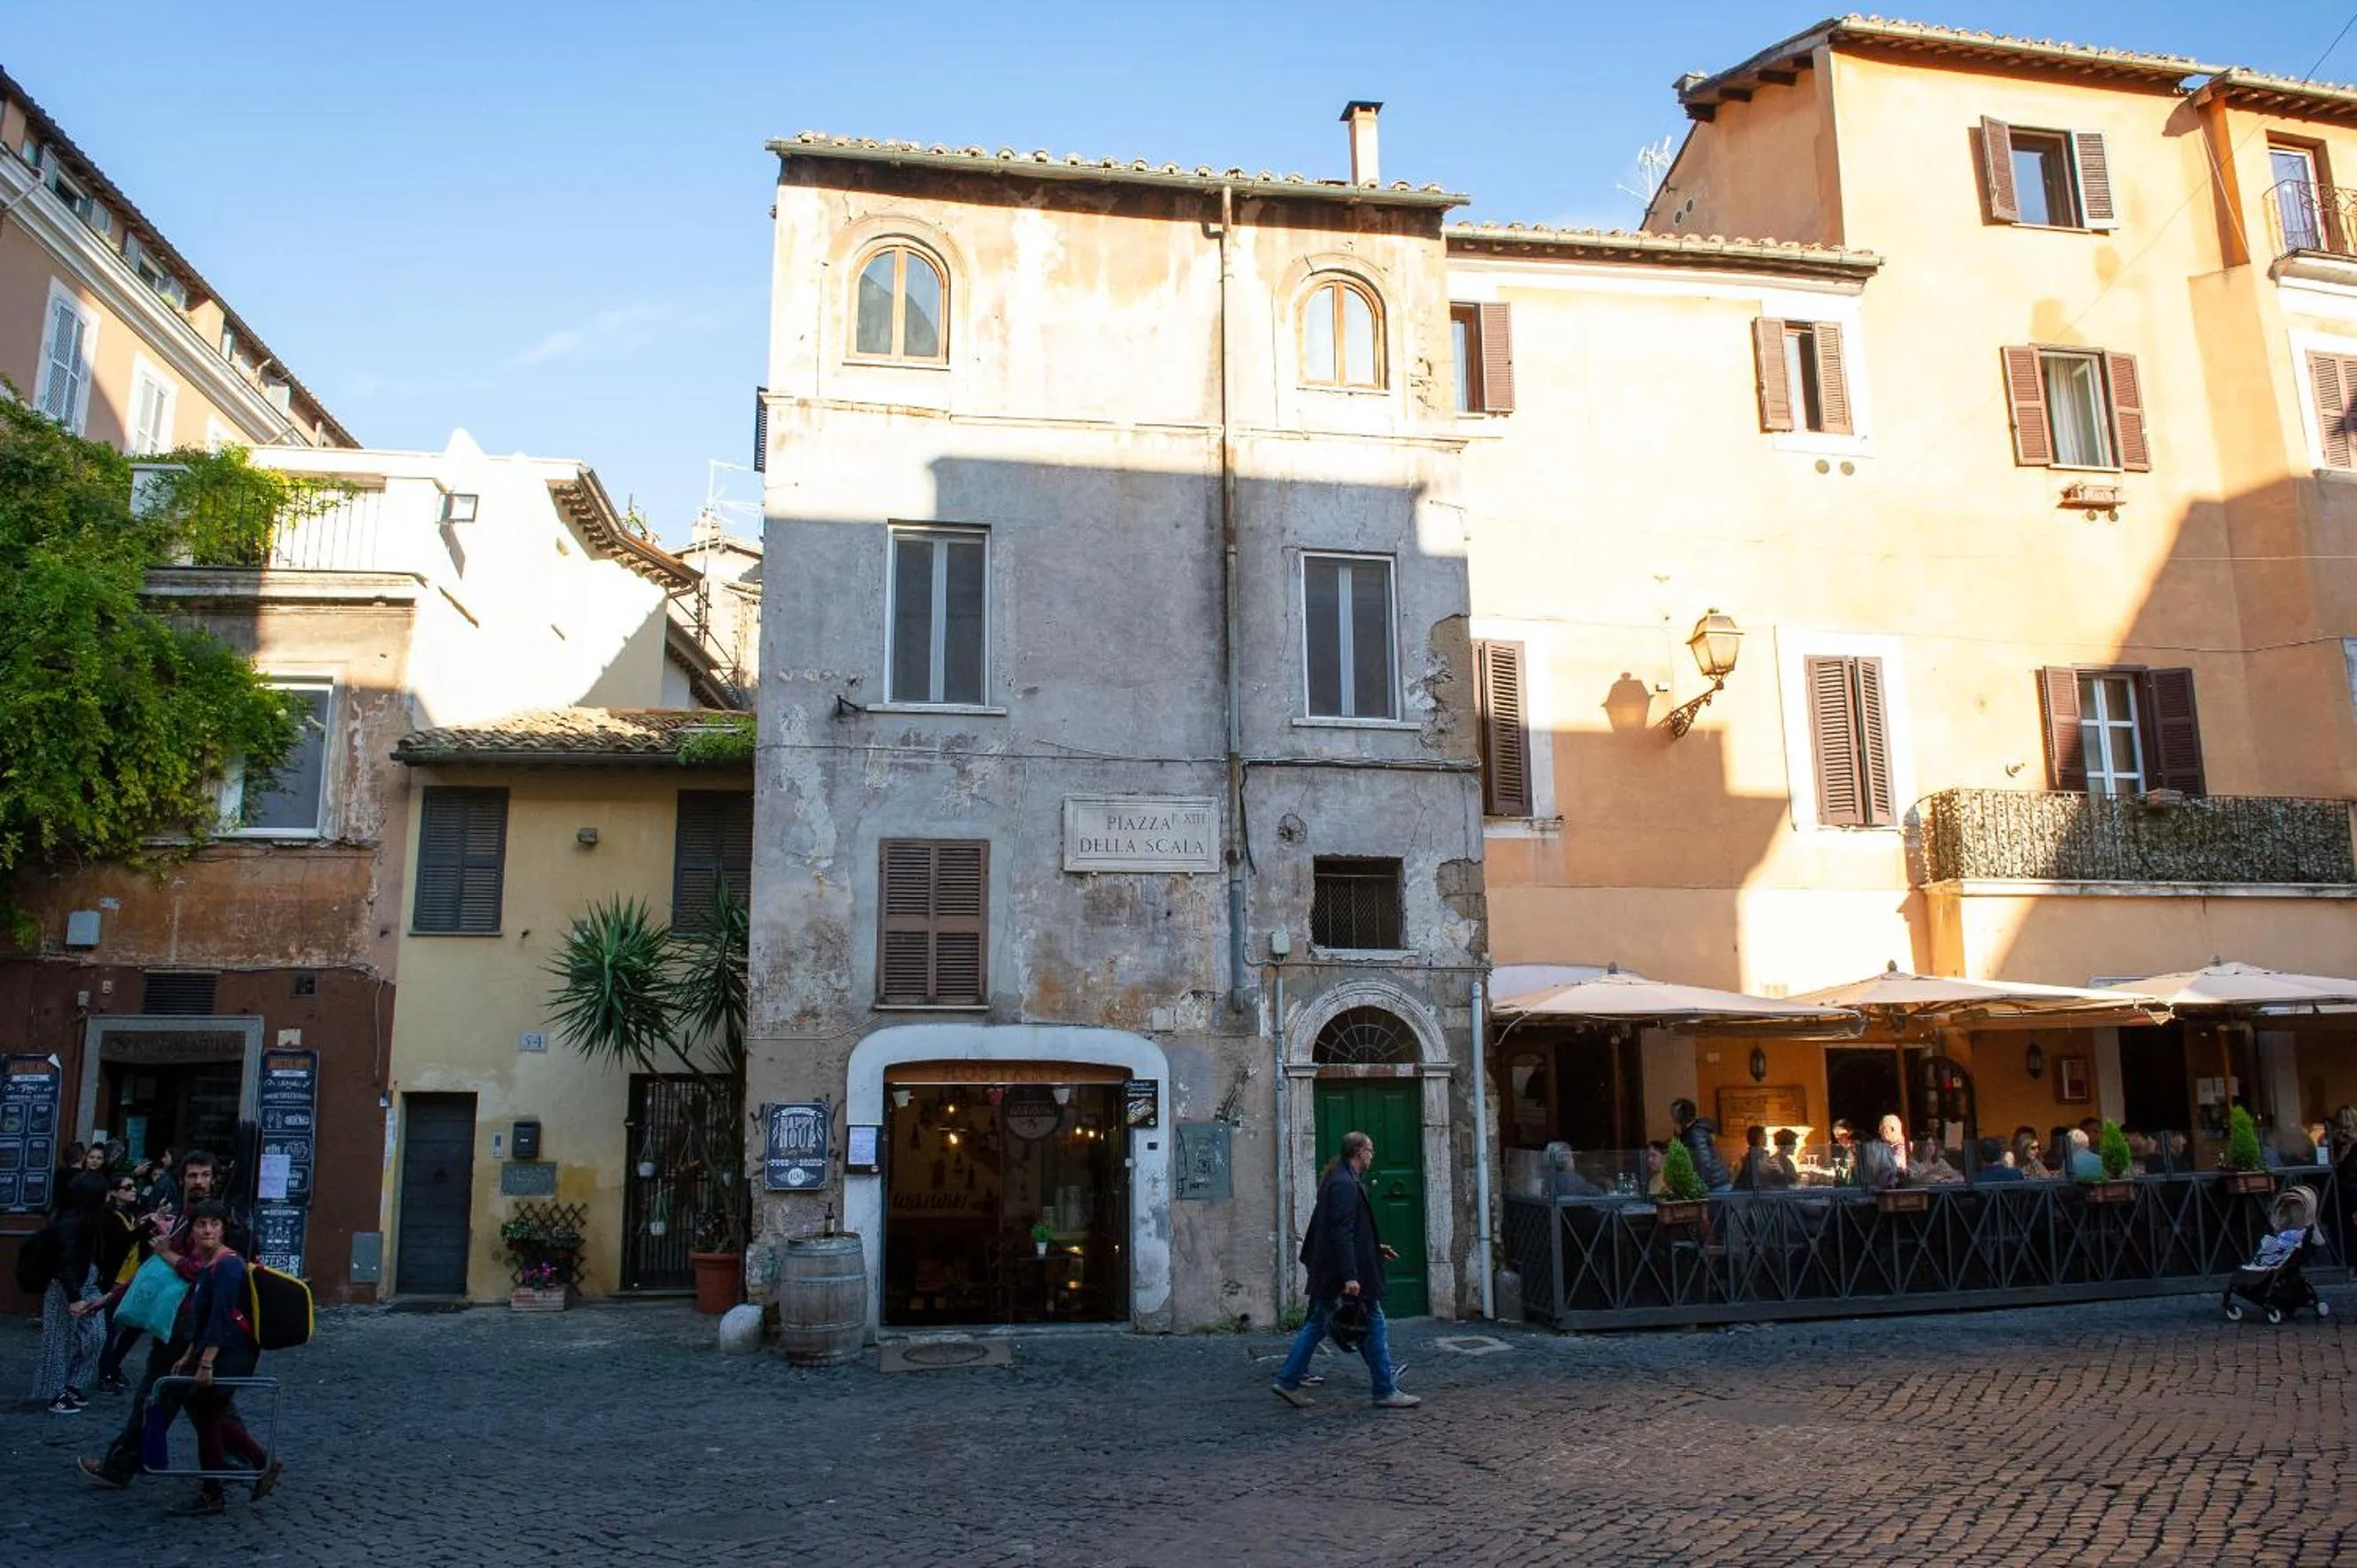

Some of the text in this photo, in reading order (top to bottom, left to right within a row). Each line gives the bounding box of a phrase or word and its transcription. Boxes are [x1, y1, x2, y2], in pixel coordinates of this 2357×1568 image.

[1106, 814, 1171, 831] PIAZZA
[1079, 836, 1205, 854] DELLA SCALA
[779, 1127, 816, 1148] HOUR
